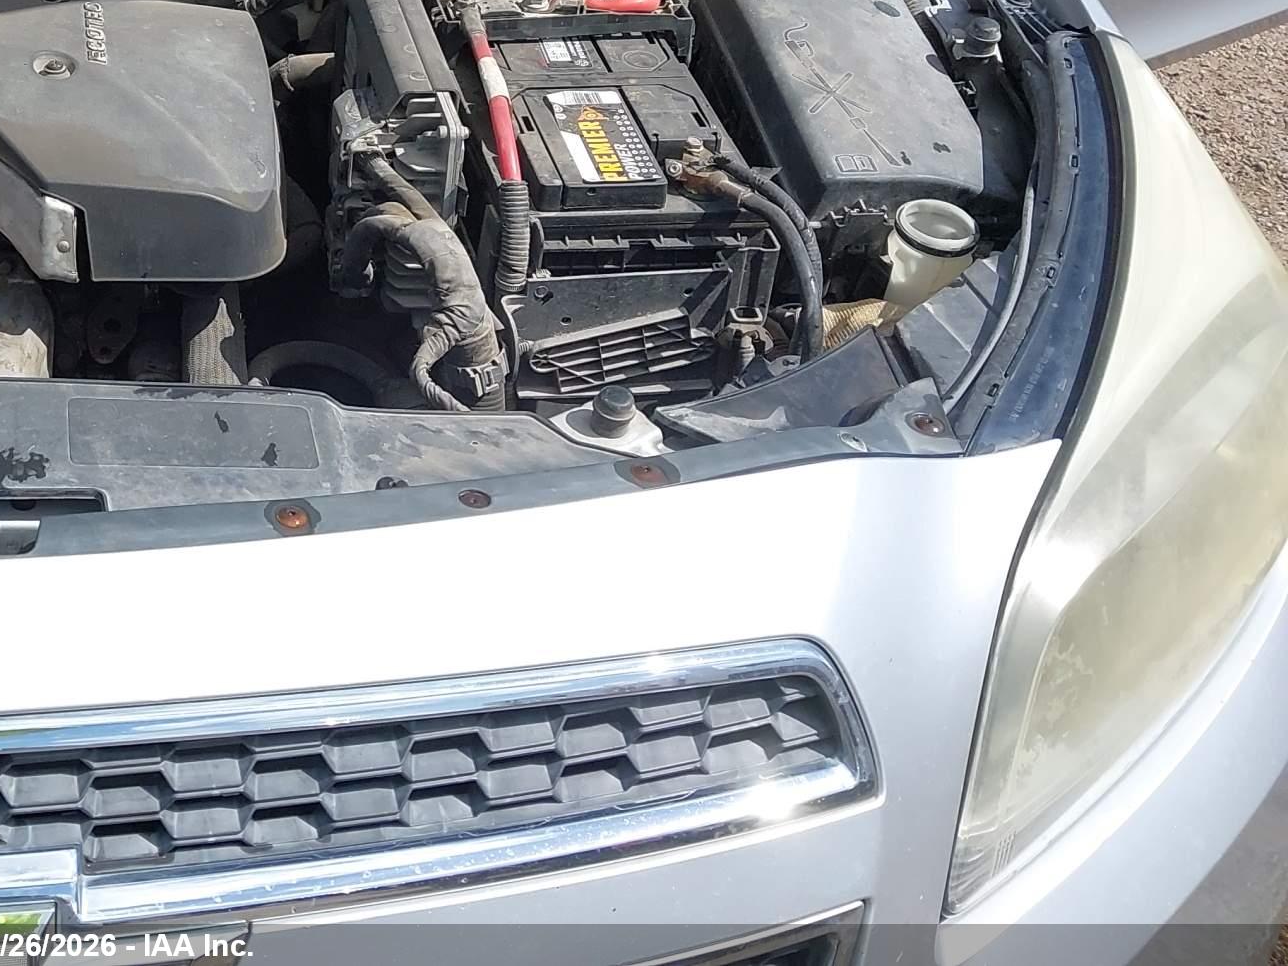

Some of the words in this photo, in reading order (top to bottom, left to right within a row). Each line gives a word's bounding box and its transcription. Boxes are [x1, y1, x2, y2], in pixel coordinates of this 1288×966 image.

[83, 1, 107, 65] ECOTEC
[578, 122, 629, 181] PREMIER
[614, 143, 644, 180] POWER
